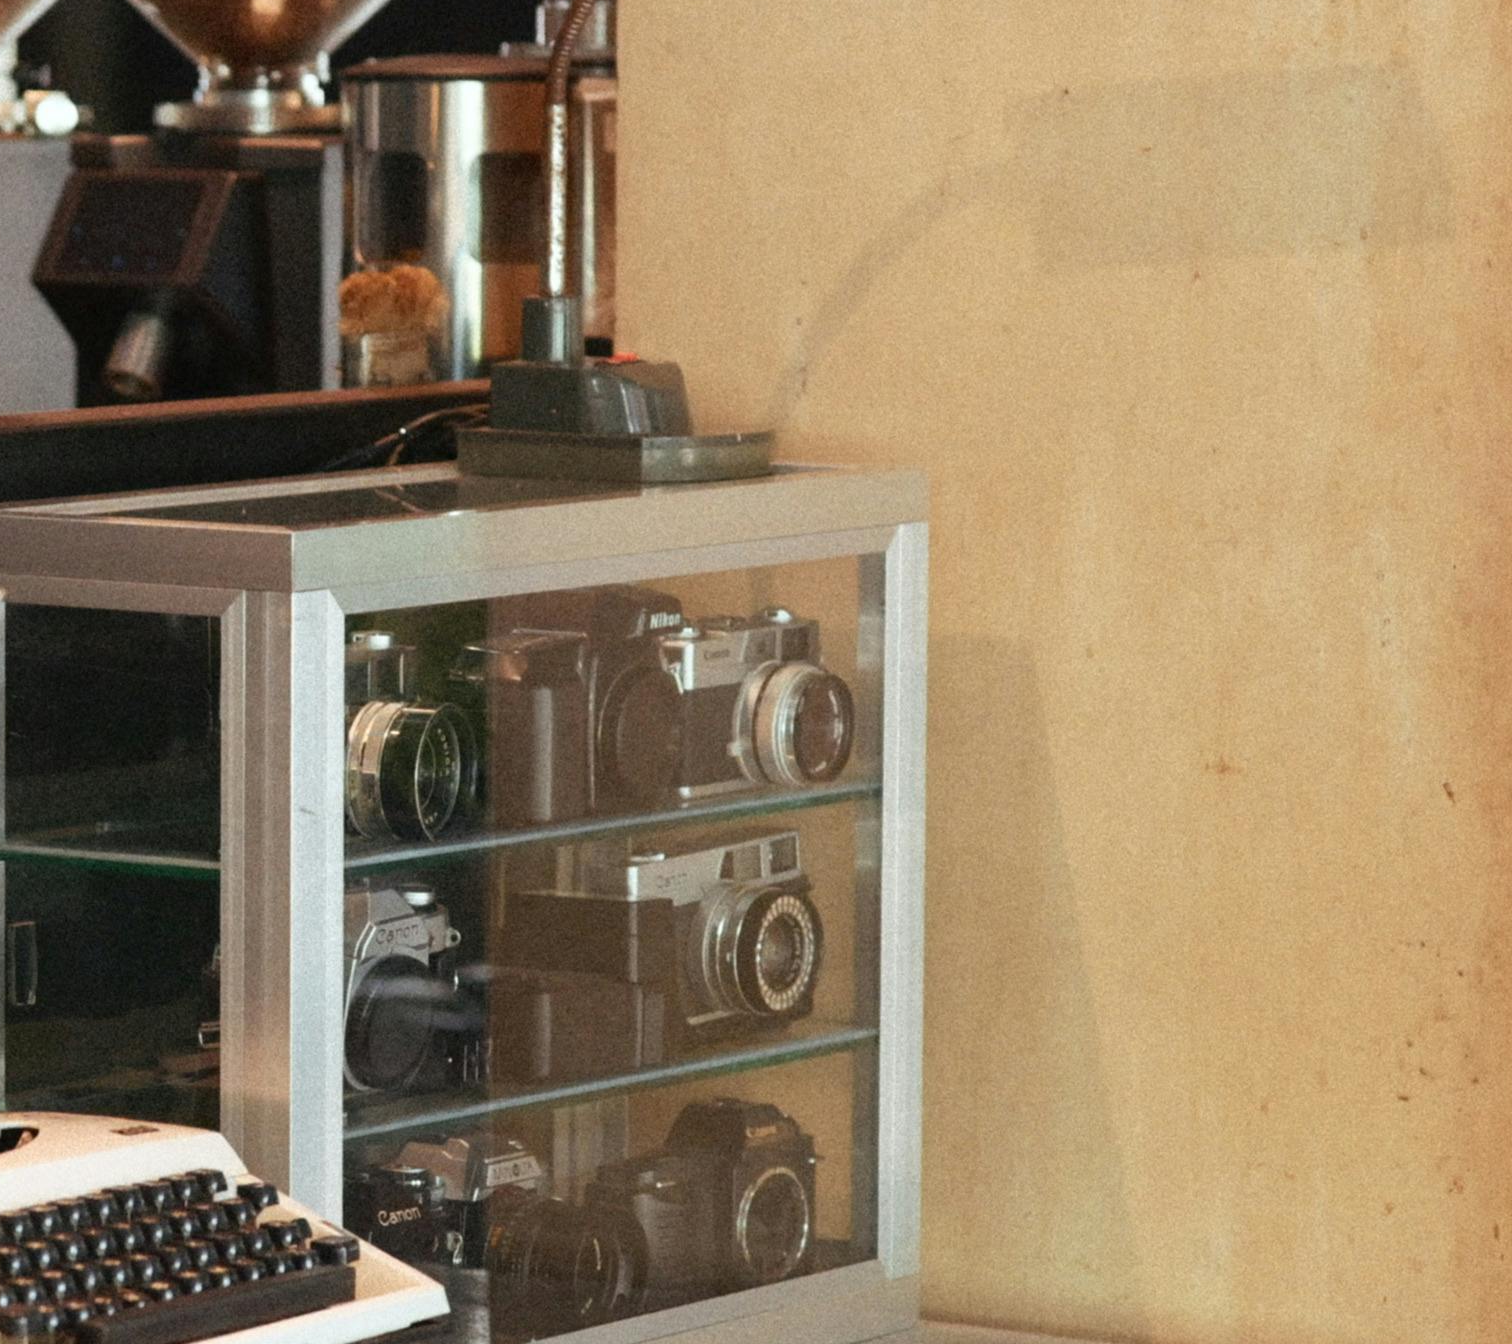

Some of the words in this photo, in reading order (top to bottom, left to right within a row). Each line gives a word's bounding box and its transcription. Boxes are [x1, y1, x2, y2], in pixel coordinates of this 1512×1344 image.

[650, 612, 681, 629] Nikon
[375, 924, 419, 945] Canon
[377, 1206, 422, 1227] Canon
